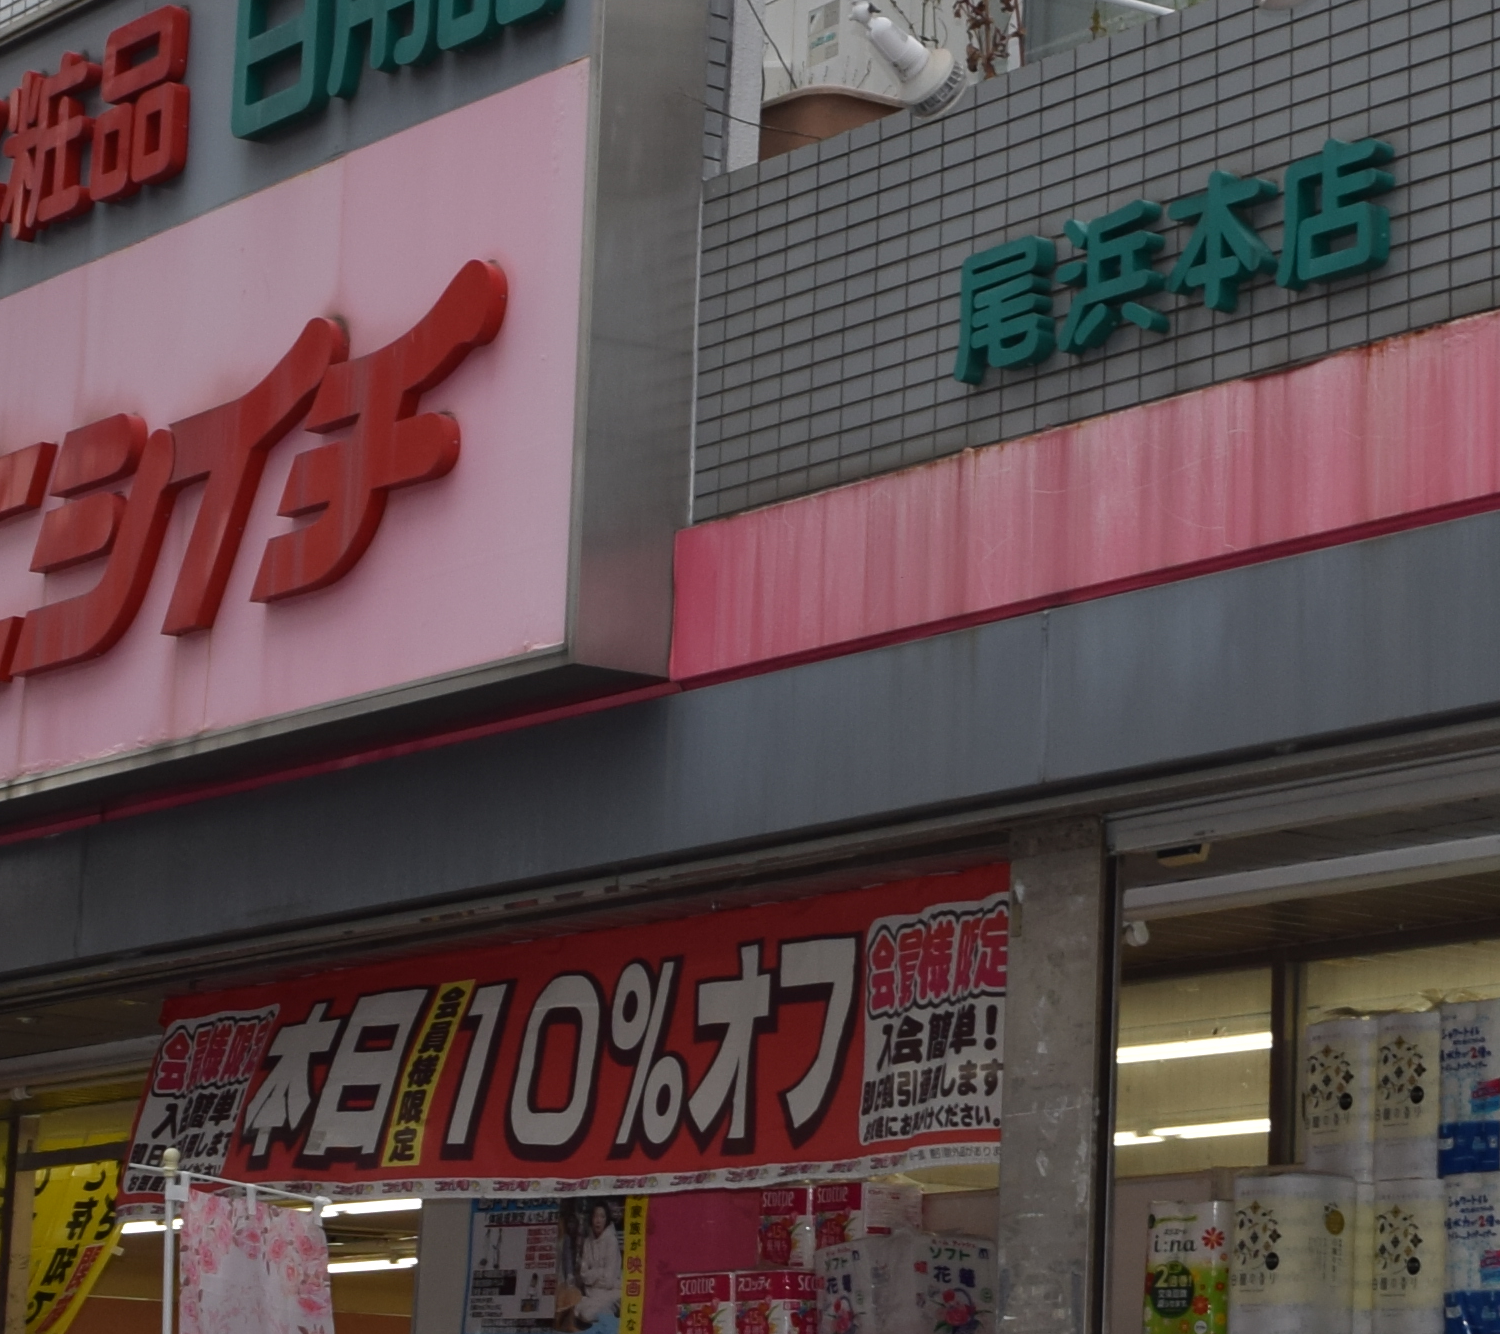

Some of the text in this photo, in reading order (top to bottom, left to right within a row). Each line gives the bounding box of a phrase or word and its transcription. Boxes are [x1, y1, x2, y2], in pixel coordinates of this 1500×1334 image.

[952, 134, 1397, 387] 尾浜本店
[389, 986, 466, 1163] 会員様限定
